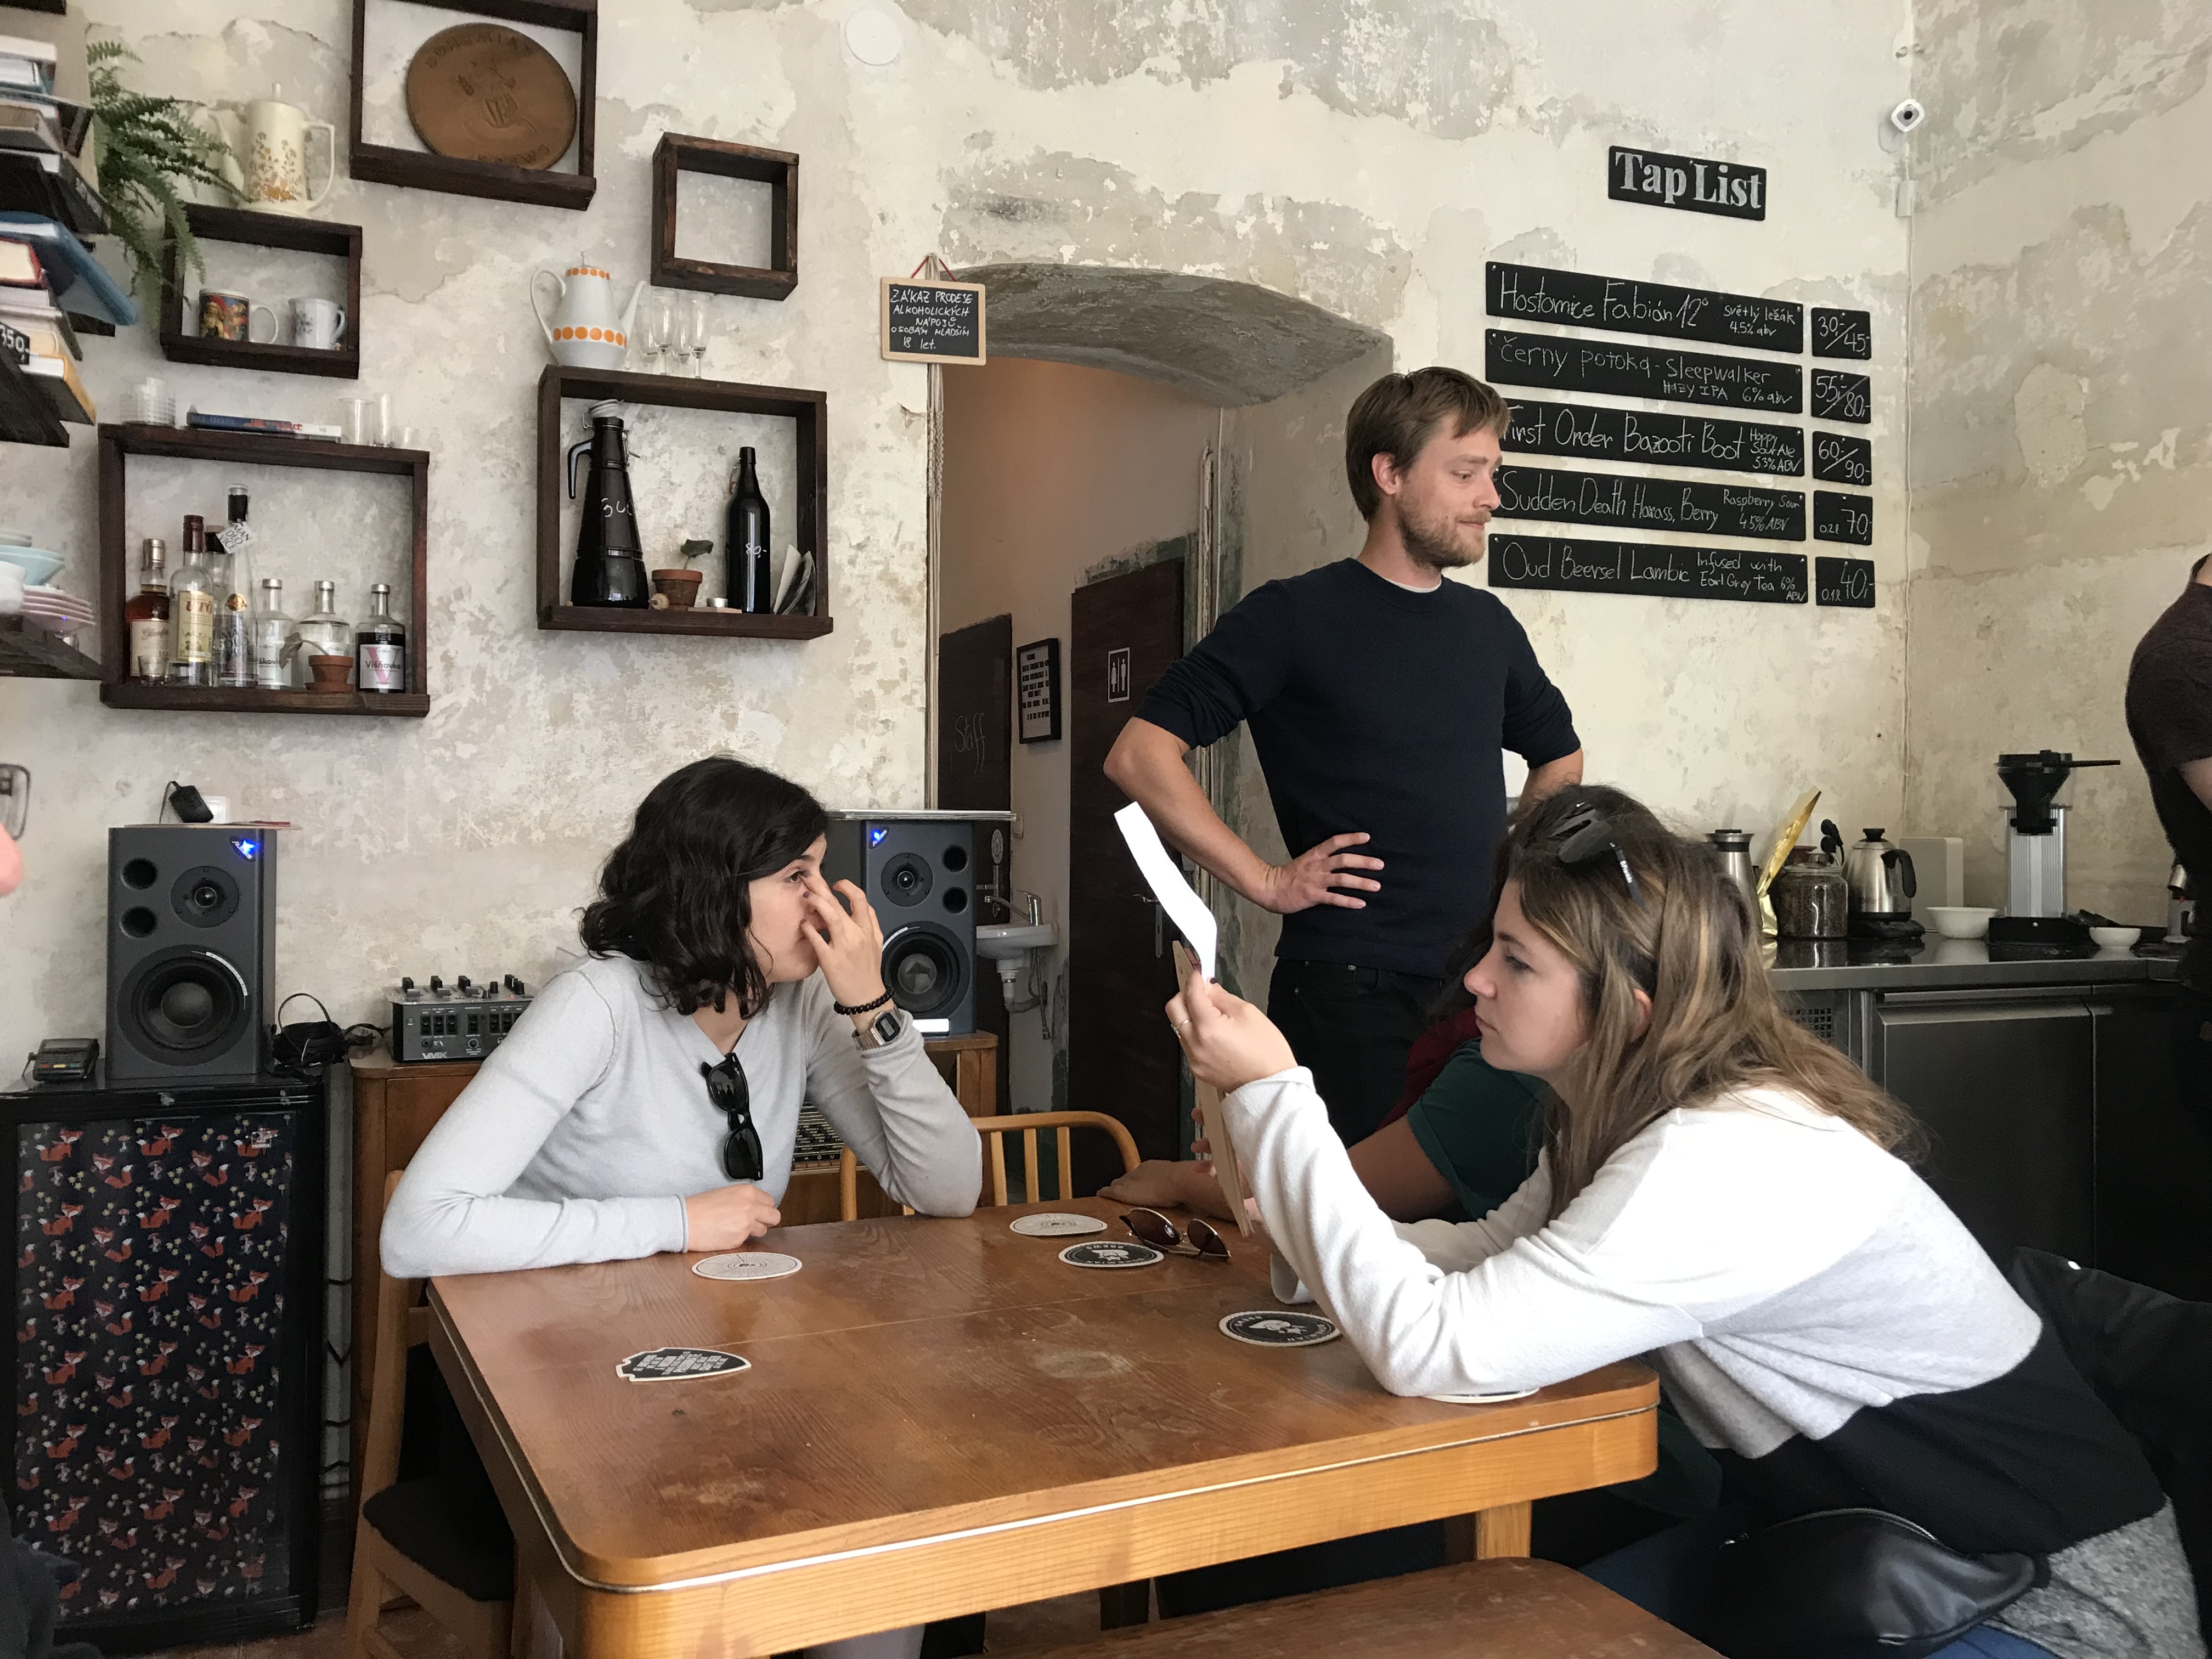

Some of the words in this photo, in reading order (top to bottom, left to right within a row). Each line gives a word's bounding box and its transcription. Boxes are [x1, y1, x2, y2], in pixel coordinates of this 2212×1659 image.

[1615, 151, 1687, 204] Tap
[1693, 163, 1763, 209] List
[890, 289, 930, 303] ZÁKAZ
[935, 291, 973, 304] PRODEJE
[1603, 280, 1673, 322] Fabián
[1676, 294, 1709, 328] 12°
[893, 304, 970, 317] ALKOHOLICKÝCH
[1723, 304, 1760, 323] Světlý
[1765, 306, 1796, 325] ležák
[891, 325, 928, 335] OSOBÁM
[935, 325, 969, 336] MLADŠÍM
[915, 317, 957, 327] NÁPOJŮ
[1757, 324, 1777, 336] abv
[904, 336, 912, 348] 18
[920, 338, 936, 349] let.
[1666, 356, 1771, 385] Sleepwalker
[1700, 385, 1728, 400] IPA
[1742, 387, 1764, 403] 6%
[1555, 409, 1613, 448] Order
[1624, 412, 1695, 454] Bazooti
[1702, 421, 1746, 459] Boot
[1750, 428, 1778, 448] Hoppy
[1750, 441, 1776, 455] Sour
[1777, 443, 1796, 458] Ale
[1777, 458, 1803, 472] ABV
[1500, 471, 1576, 511] Sudden
[1579, 477, 1626, 515] Death
[1681, 487, 1719, 530] Berry
[1723, 488, 1775, 516] Raspberry
[1765, 517, 1790, 531] ABV
[1503, 542, 1551, 580] Oud
[1561, 543, 1622, 580] Beersel
[1697, 551, 1741, 574] Infused
[1750, 558, 1782, 572] with
[1700, 571, 1723, 586] Earl
[1726, 573, 1752, 595] Grey
[1753, 574, 1775, 591] Tea
[1781, 577, 1795, 591] 6%
[1786, 591, 1807, 602] ABV
[365, 660, 401, 669] Višňovka
[955, 712, 986, 775] Staff
